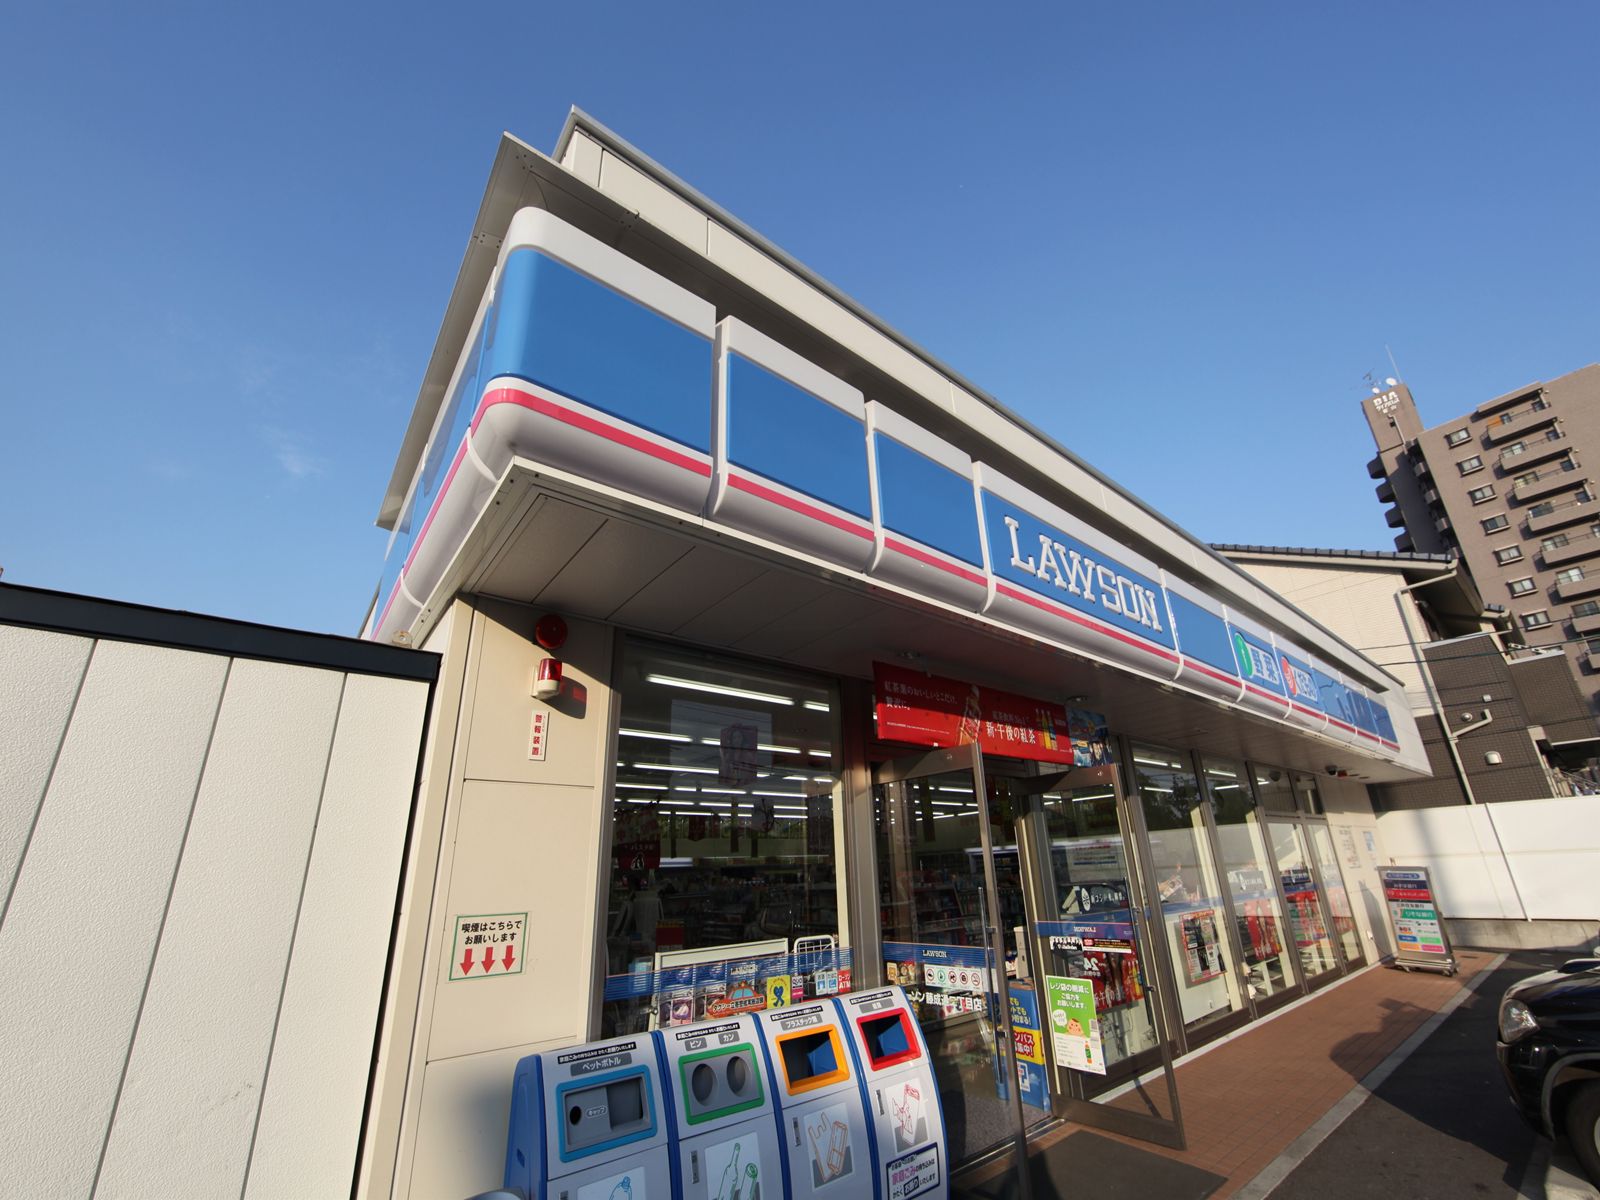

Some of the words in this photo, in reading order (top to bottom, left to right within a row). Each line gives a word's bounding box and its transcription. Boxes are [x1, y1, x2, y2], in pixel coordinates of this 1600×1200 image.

[1373, 391, 1398, 406] DIA
[1004, 515, 1164, 633] LAWSON
[1250, 648, 1278, 682] 野菜
[531, 714, 543, 756] 警報装置
[461, 920, 523, 933] 喫煙はこちらで
[464, 932, 517, 945] お願いします
[922, 949, 948, 958] LAWSON
[839, 980, 851, 989] ATM
[689, 1039, 702, 1049] ビン
[722, 1033, 735, 1042] カン
[582, 1056, 622, 1070] ペットボトル
